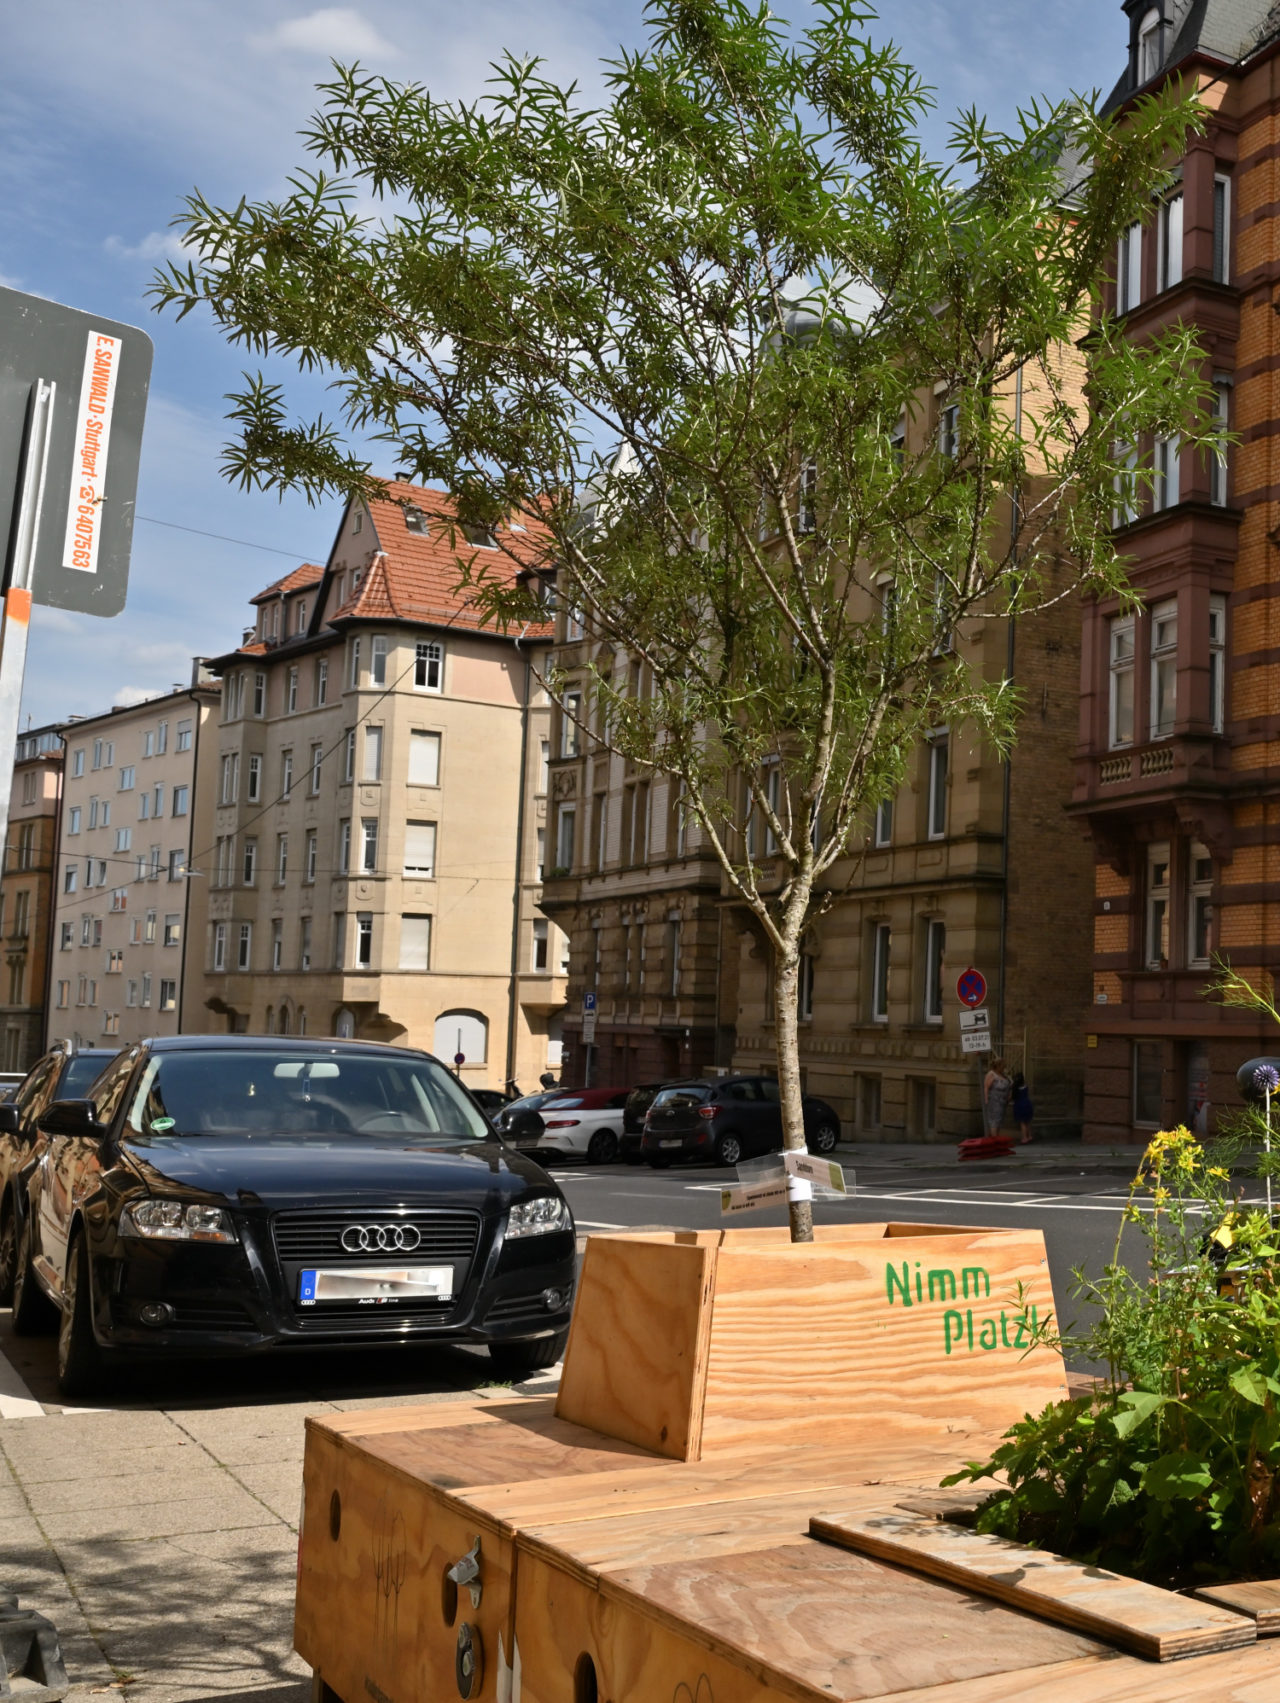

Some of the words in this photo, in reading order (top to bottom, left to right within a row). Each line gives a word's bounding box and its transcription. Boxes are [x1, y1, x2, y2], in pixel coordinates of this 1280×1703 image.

[97, 335, 114, 346] E.
[88, 348, 112, 414] SANWALD
[80, 419, 103, 477] Stuttgart
[72, 504, 95, 568] 6407563
[586, 994, 594, 1008] P
[886, 1261, 990, 1307] Nimm
